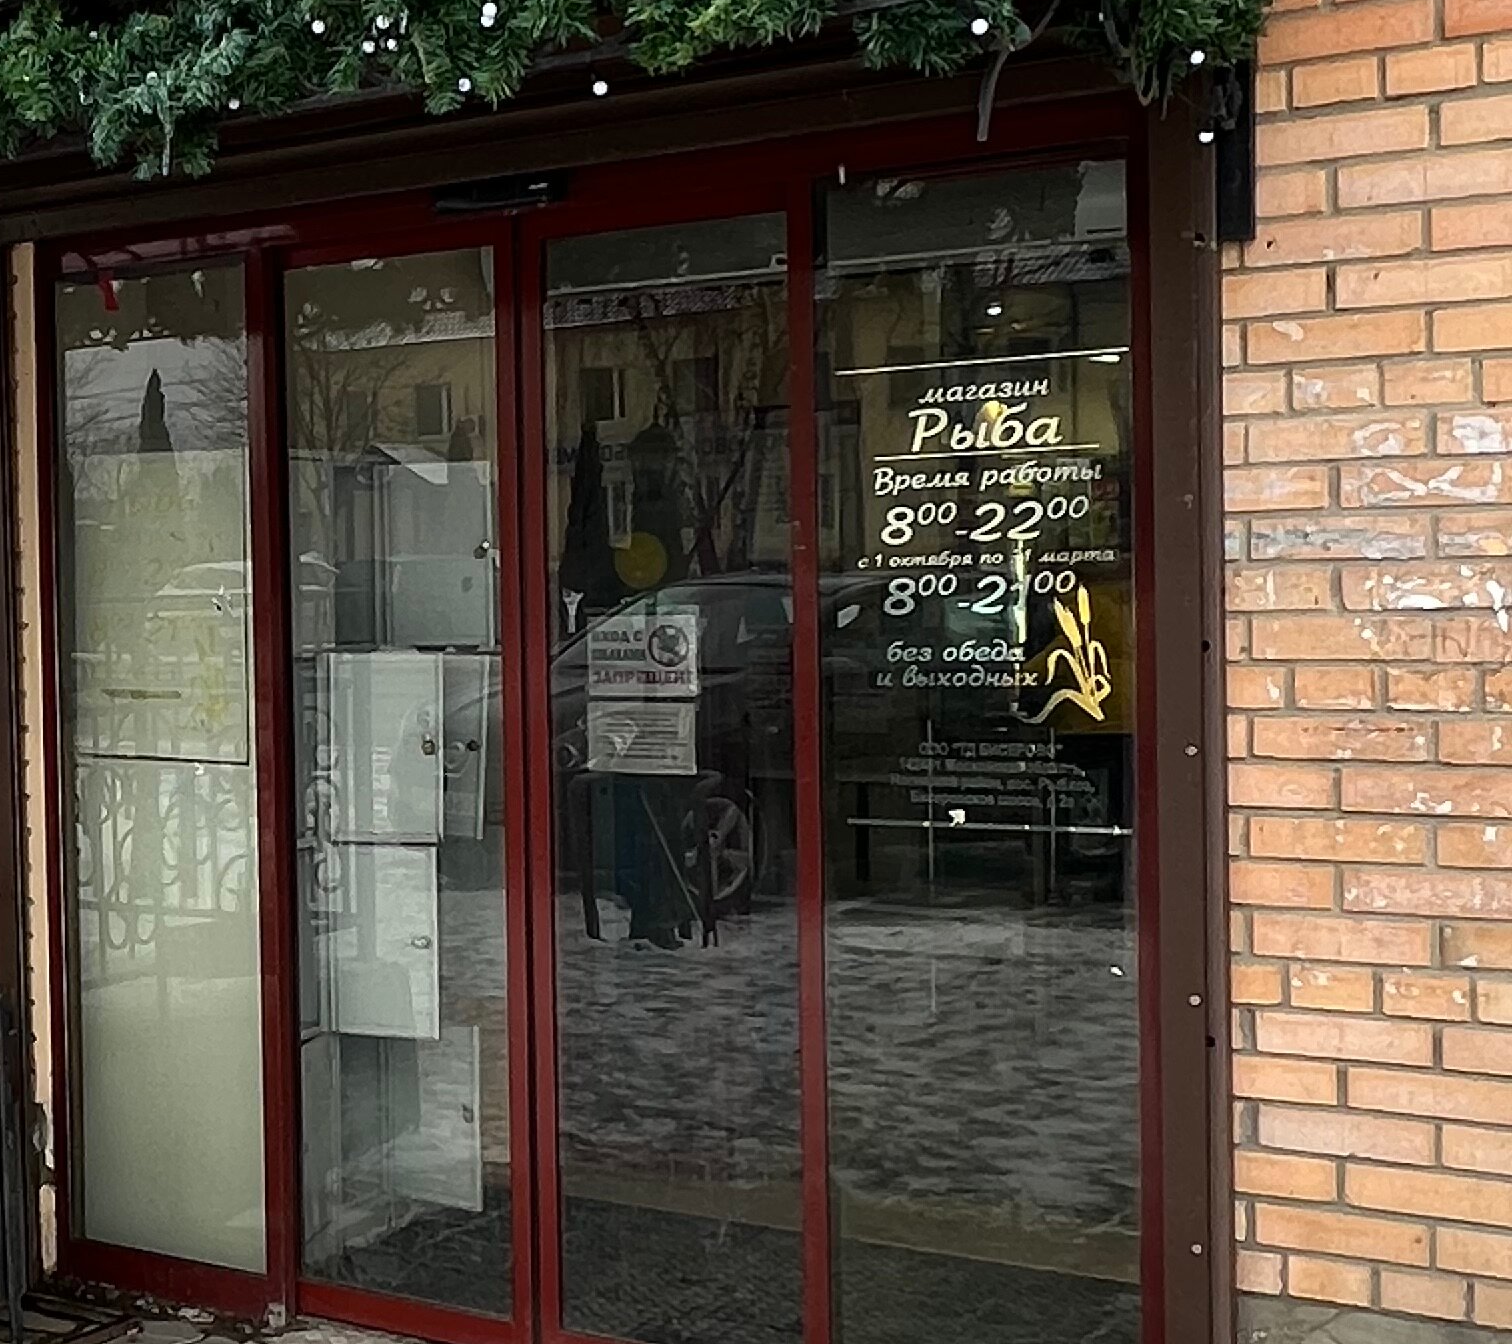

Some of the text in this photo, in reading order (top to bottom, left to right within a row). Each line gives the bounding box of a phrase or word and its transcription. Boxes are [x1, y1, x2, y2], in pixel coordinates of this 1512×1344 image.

[918, 377, 1050, 404] магазин
[908, 401, 1064, 453] Рыба
[873, 459, 1103, 496] Время работы
[857, 558, 870, 569] с
[874, 553, 883, 567] 1
[889, 550, 974, 569] октября
[979, 553, 1004, 565] по
[1038, 548, 1116, 566] марта
[592, 630, 643, 644] ВХОД С
[888, 639, 1026, 663] без обеда
[876, 664, 1039, 687] и выходных
